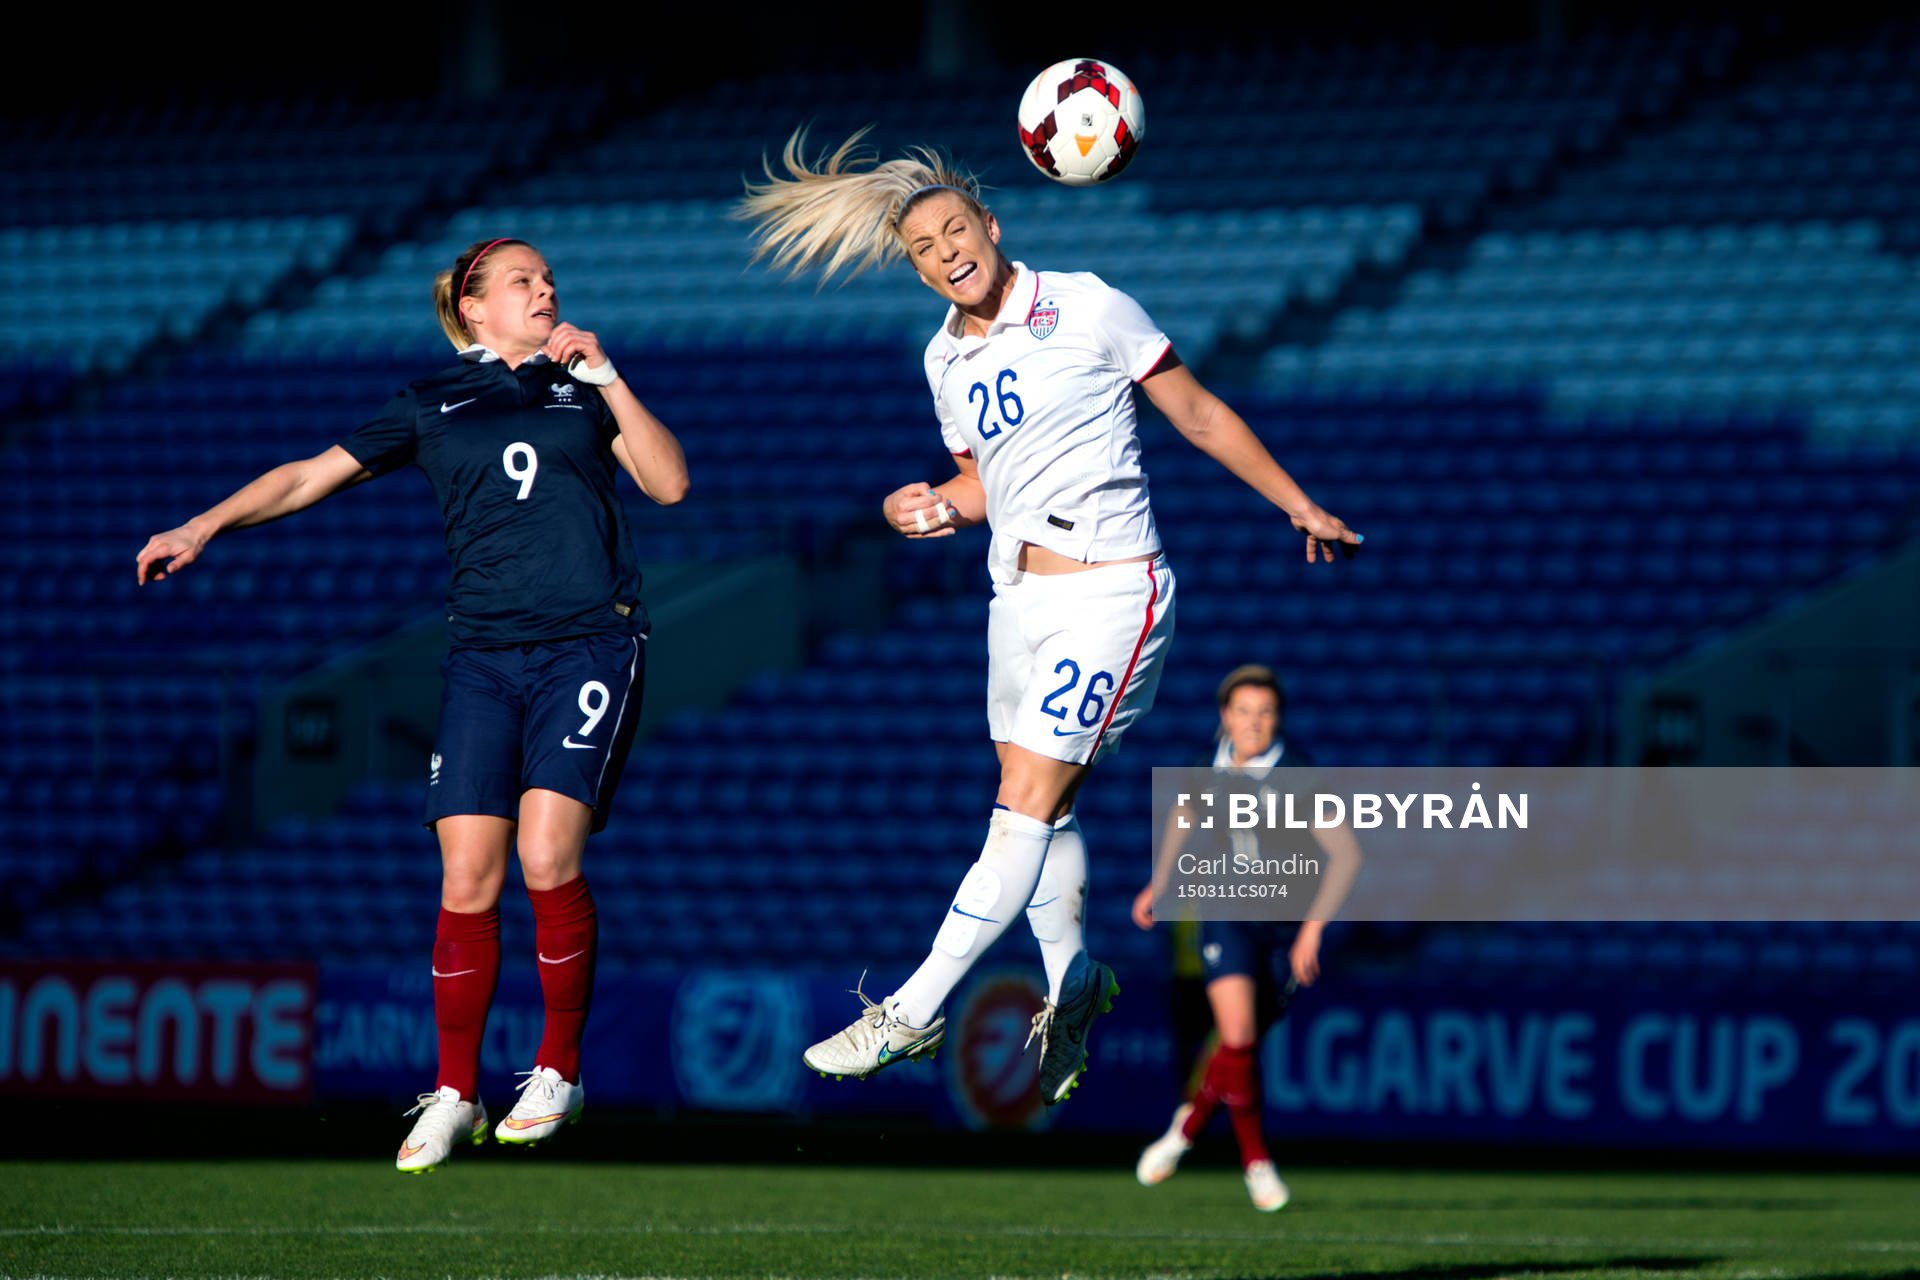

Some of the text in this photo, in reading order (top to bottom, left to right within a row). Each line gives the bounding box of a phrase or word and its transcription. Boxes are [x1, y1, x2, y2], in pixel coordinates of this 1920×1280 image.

[968, 368, 1025, 441] 26
[502, 441, 539, 500] 9
[577, 680, 611, 737] 9
[1040, 658, 1114, 728] 26
[1620, 1016, 1799, 1123] CUP
[1825, 1018, 1920, 1128] 20
